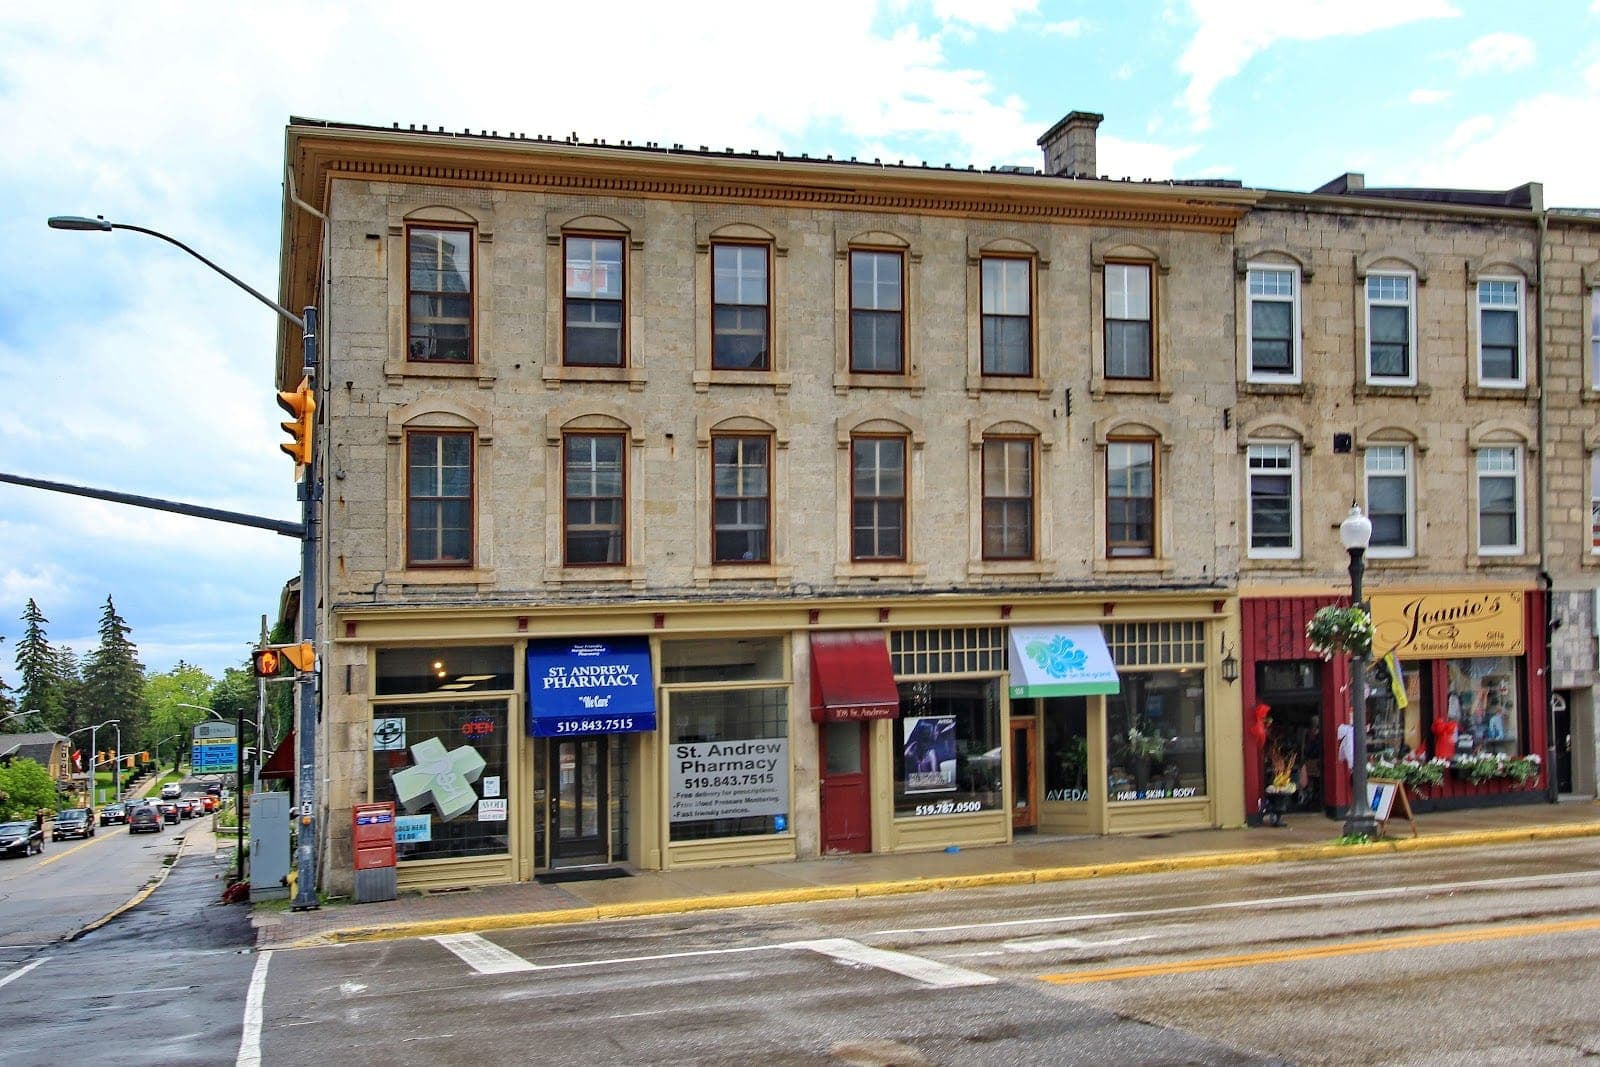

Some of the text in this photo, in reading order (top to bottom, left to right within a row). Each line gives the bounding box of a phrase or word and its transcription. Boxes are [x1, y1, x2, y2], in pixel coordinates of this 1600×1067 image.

[548, 665, 630, 677] ST. ANDREW
[543, 674, 639, 689] PHARMACY
[861, 707, 890, 717] Andrew
[461, 723, 495, 734] OPEN
[557, 718, 633, 732] 519.843.7515
[676, 742, 782, 759] St. Andrew
[681, 758, 778, 774] Pharmacy
[685, 773, 775, 789] 519.843.7515
[1046, 788, 1088, 800] AVEDA
[1117, 787, 1196, 801] HAIR SKIN BODY
[915, 801, 981, 815] 519.787.0500
